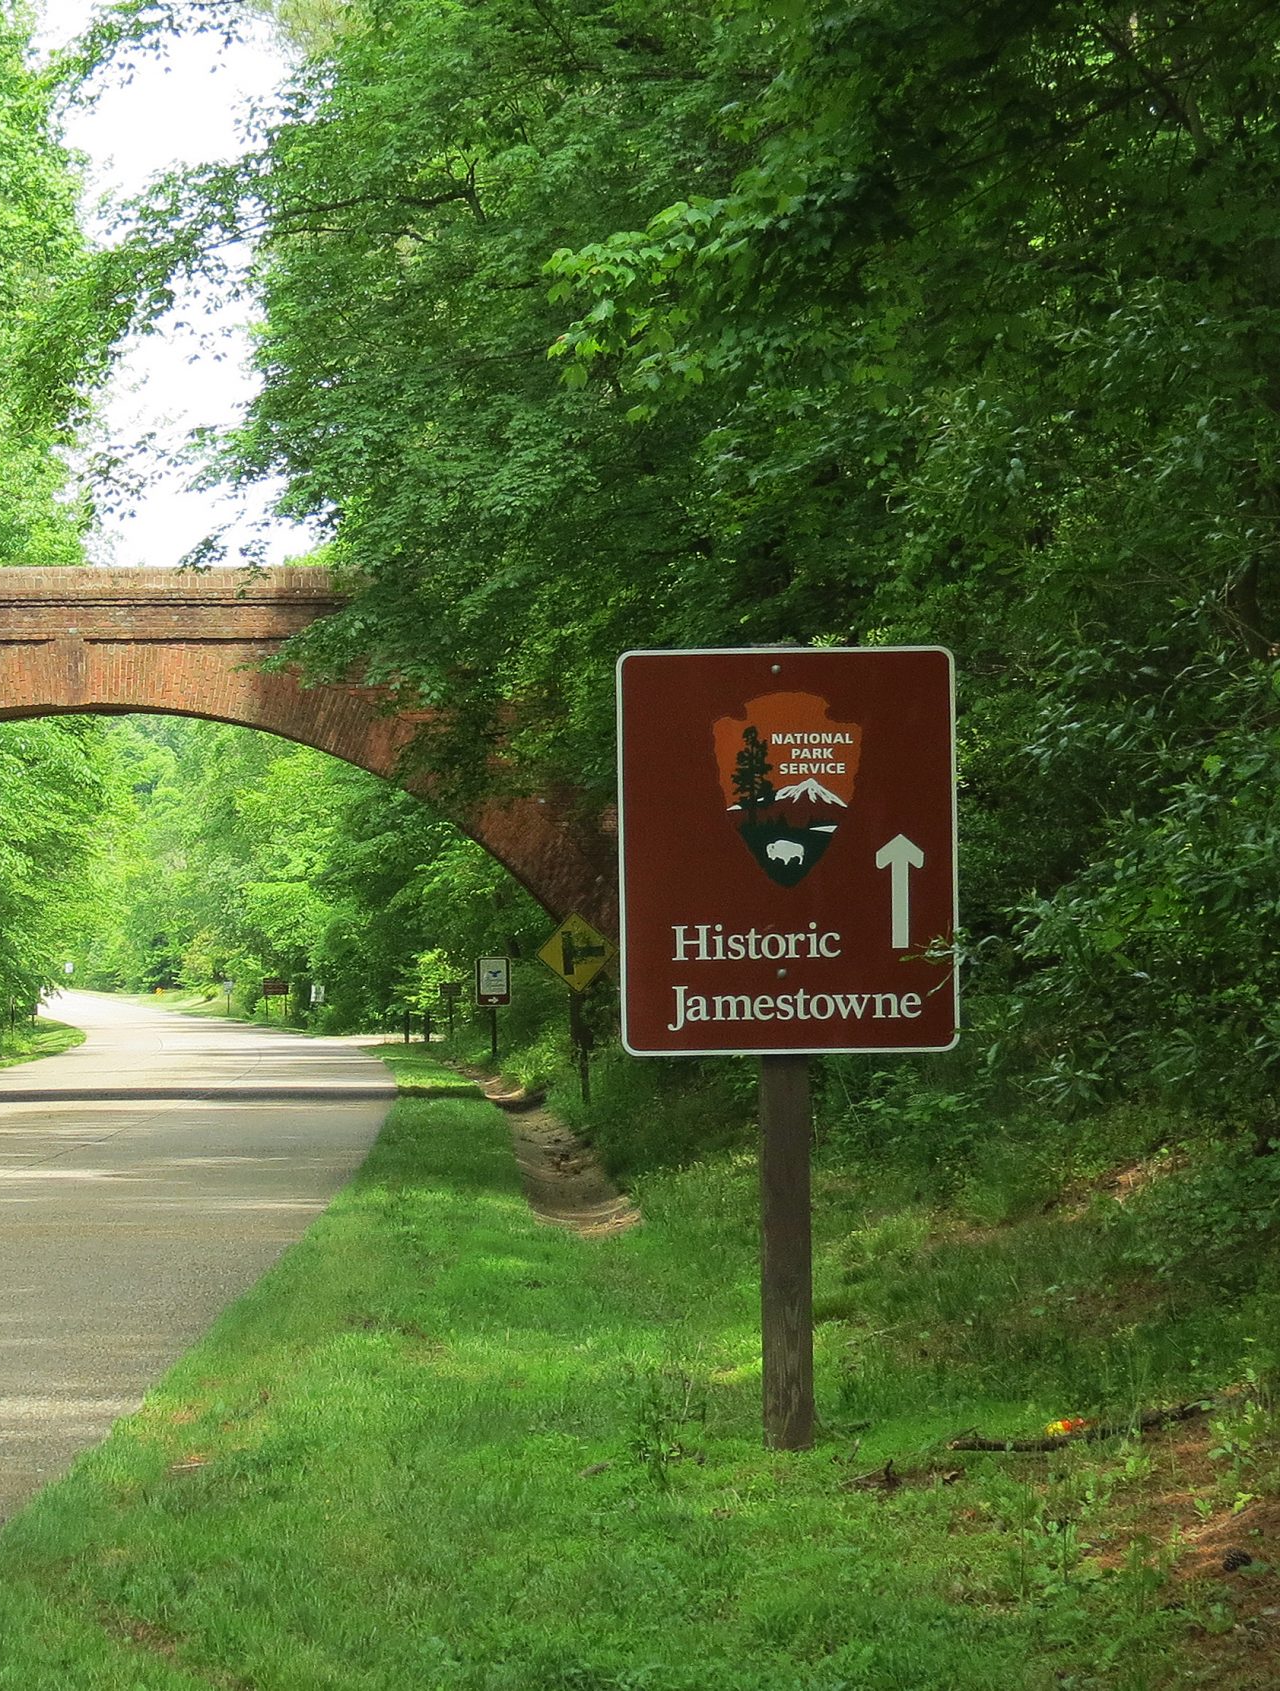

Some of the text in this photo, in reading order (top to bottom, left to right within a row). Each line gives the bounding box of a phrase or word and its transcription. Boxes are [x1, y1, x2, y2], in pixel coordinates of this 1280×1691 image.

[771, 732, 854, 745] NATIONAL
[791, 747, 834, 760] PARK
[779, 762, 846, 775] SERVICE
[670, 921, 841, 961] Historic
[667, 985, 922, 1032] Jamestowne
